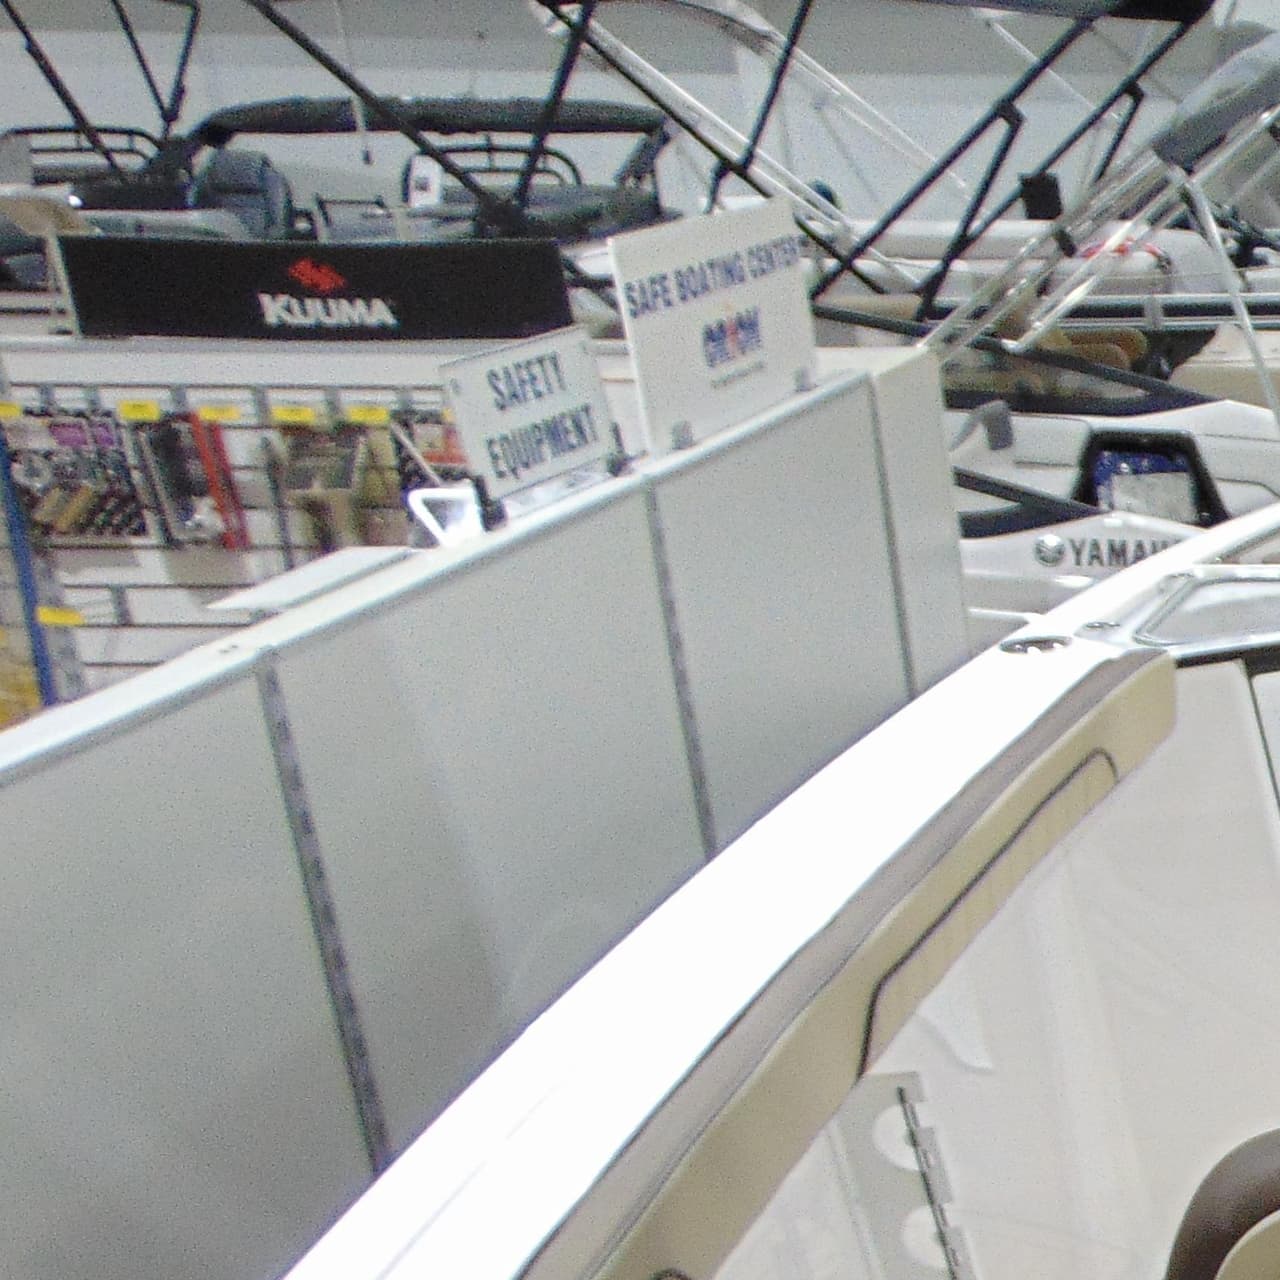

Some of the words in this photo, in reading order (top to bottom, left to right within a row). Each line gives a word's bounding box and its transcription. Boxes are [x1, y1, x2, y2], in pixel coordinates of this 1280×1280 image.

[257, 292, 400, 328] KUUMA
[624, 272, 673, 320] SAFE
[674, 250, 747, 302] BOATING
[486, 350, 567, 411] SAFETY
[485, 402, 600, 480] EQUIPMENT
